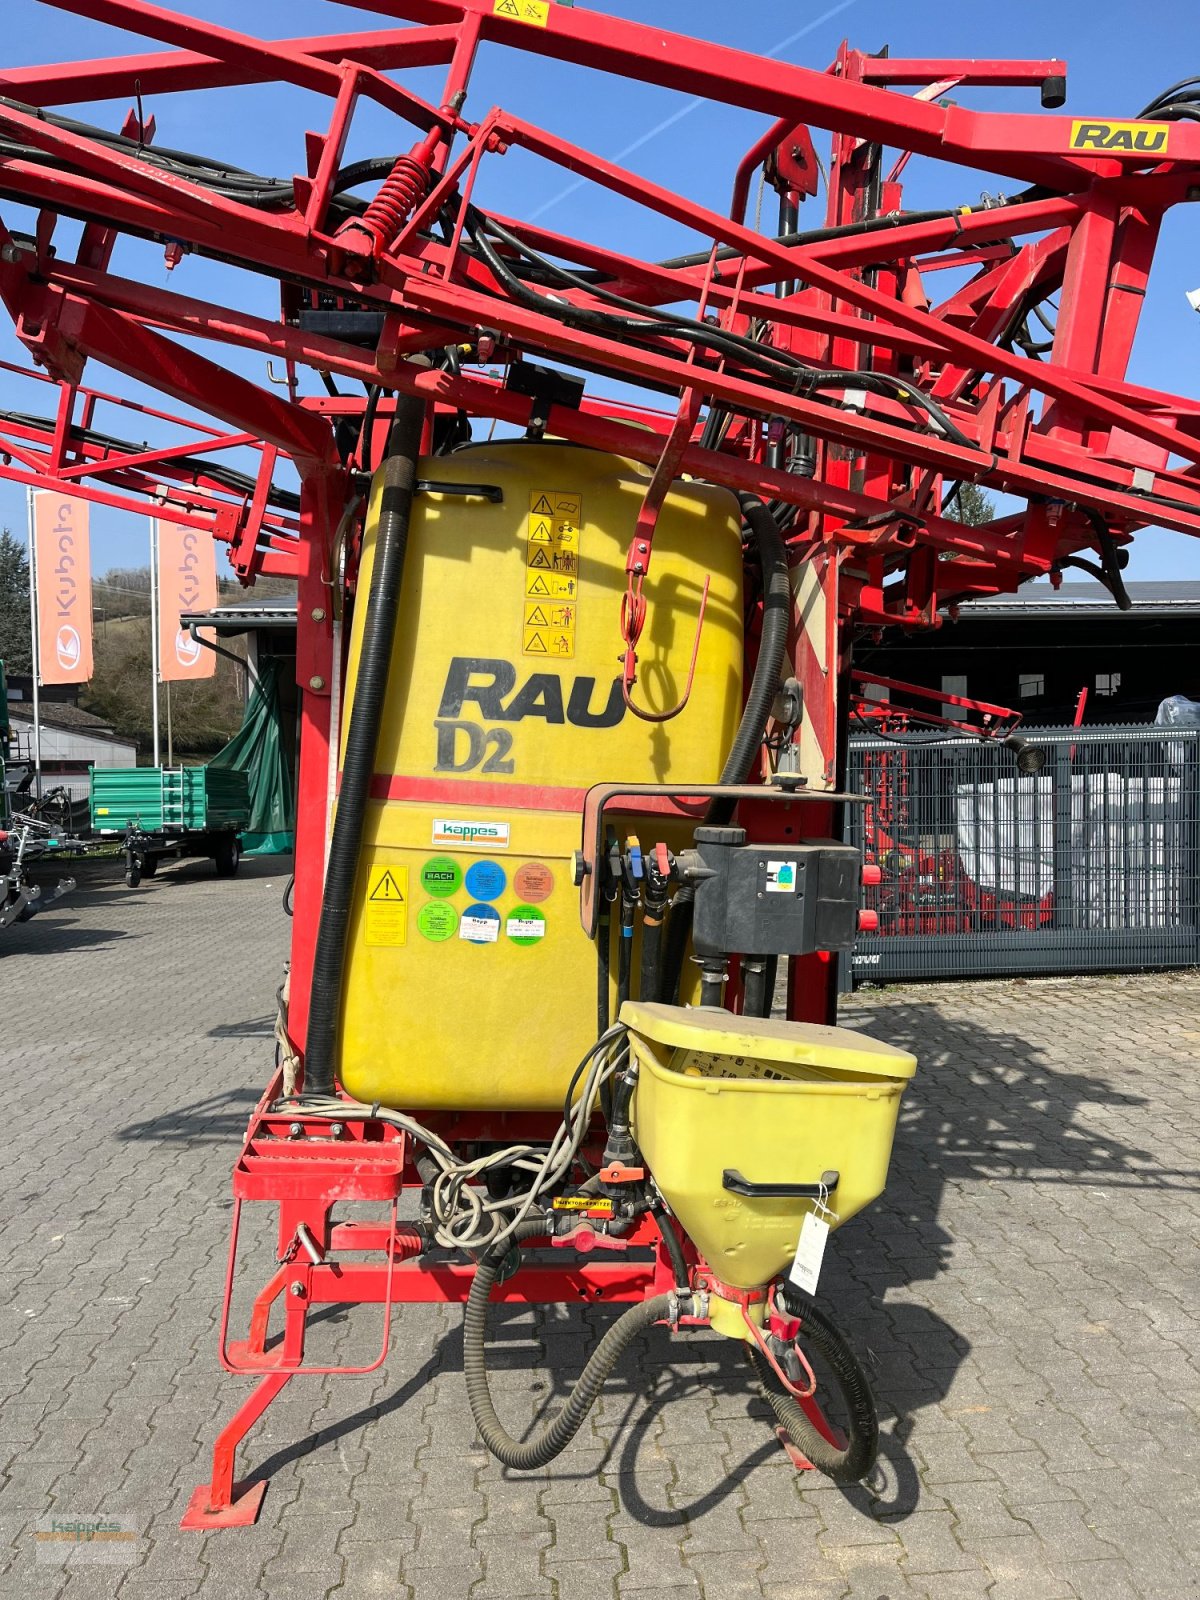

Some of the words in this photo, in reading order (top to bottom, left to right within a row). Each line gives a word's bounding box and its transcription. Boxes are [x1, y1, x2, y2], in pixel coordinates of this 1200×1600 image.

[1074, 124, 1167, 151] RAU
[52, 503, 77, 617] Kubota
[176, 526, 200, 614] Kubo
[437, 656, 633, 729] RAU
[433, 719, 516, 775] D2
[443, 823, 498, 842] kappes
